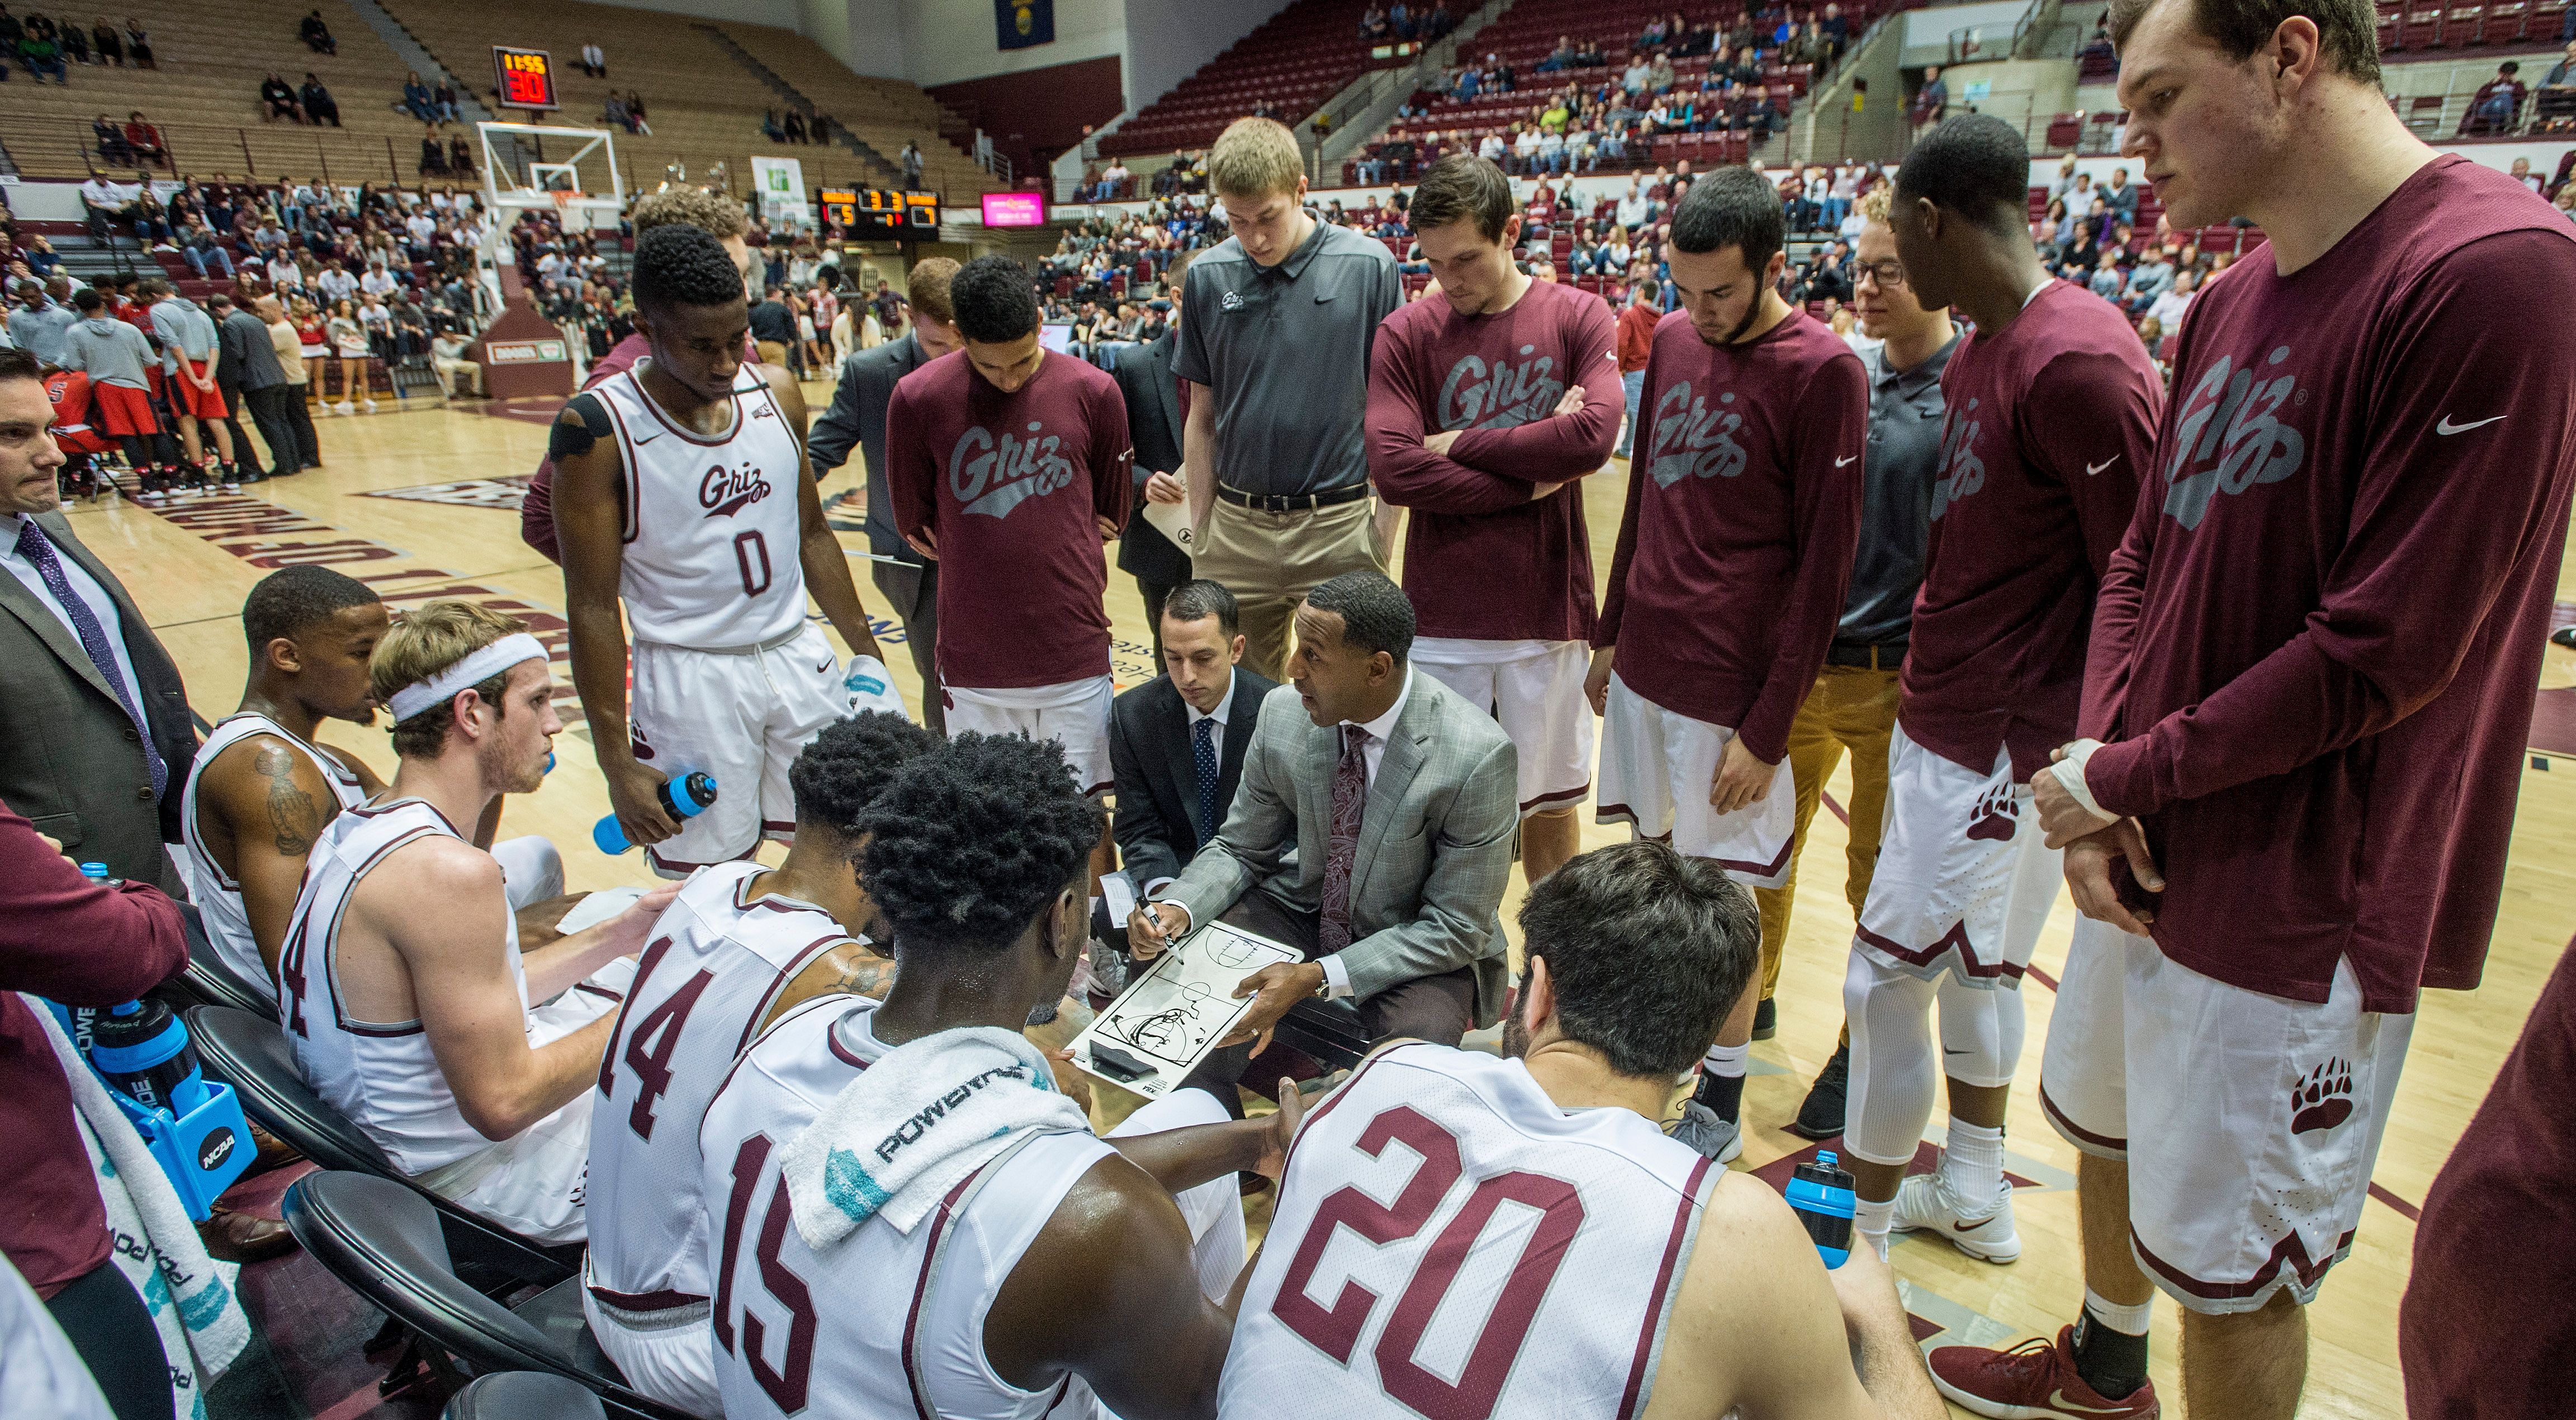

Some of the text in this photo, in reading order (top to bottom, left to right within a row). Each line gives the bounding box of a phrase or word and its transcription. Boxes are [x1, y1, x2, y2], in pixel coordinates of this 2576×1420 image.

[504, 54, 546, 75] 11:55
[507, 70, 546, 103] 30
[841, 205, 854, 225] 5
[924, 207, 935, 225] 7
[1438, 344, 1564, 431] Griz
[950, 421, 1073, 502] Griz
[1649, 381, 1748, 479] Griz
[699, 462, 771, 509] Griz
[731, 528, 772, 598] 0
[598, 934, 717, 1144] 14
[203, 1134, 236, 1170] NCAA
[712, 1130, 819, 1418] 15
[1270, 1102, 1590, 1420] 20
